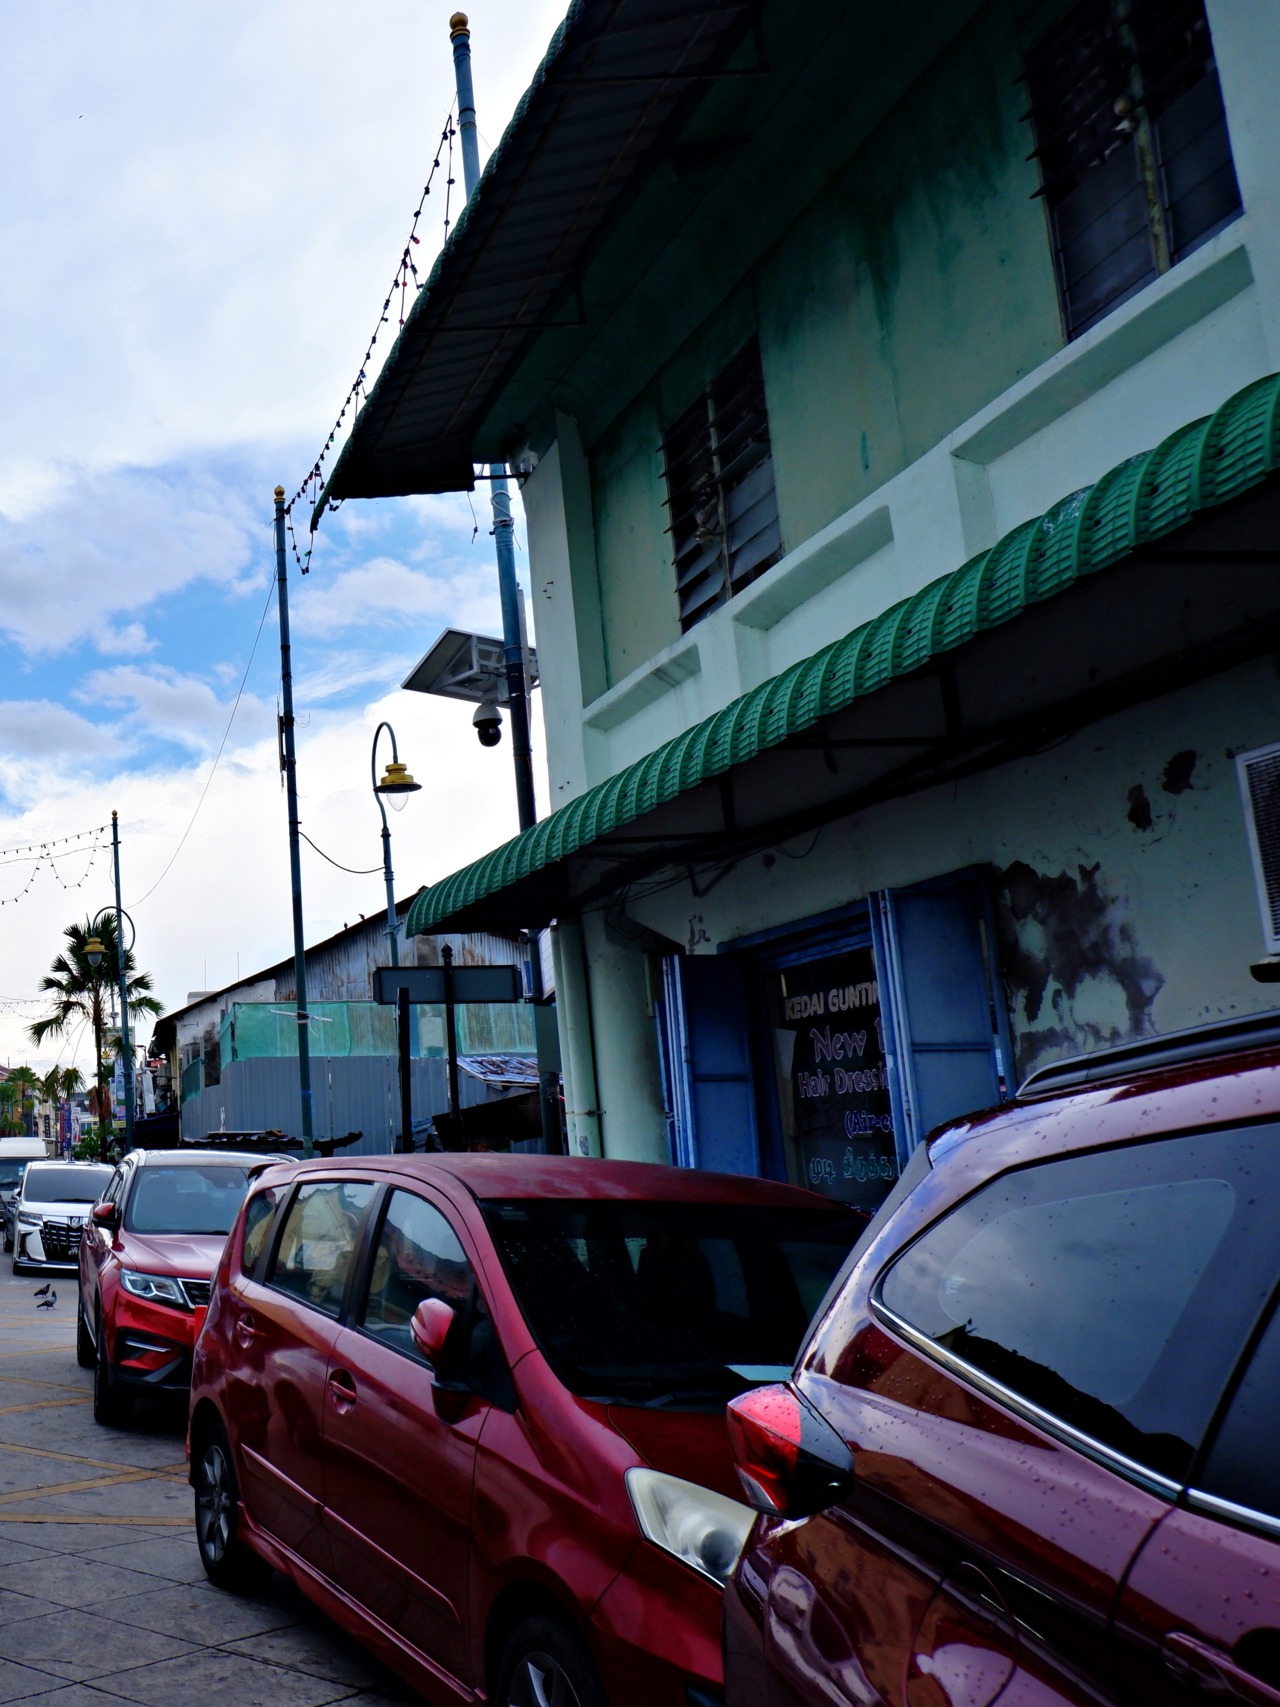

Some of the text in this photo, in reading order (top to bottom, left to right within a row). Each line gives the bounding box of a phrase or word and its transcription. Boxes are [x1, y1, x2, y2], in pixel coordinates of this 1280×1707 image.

[785, 992, 824, 1020] KEDAI
[810, 1025, 867, 1063] New
[798, 1069, 830, 1098] Hair
[844, 1110, 894, 1139] (Air-c
